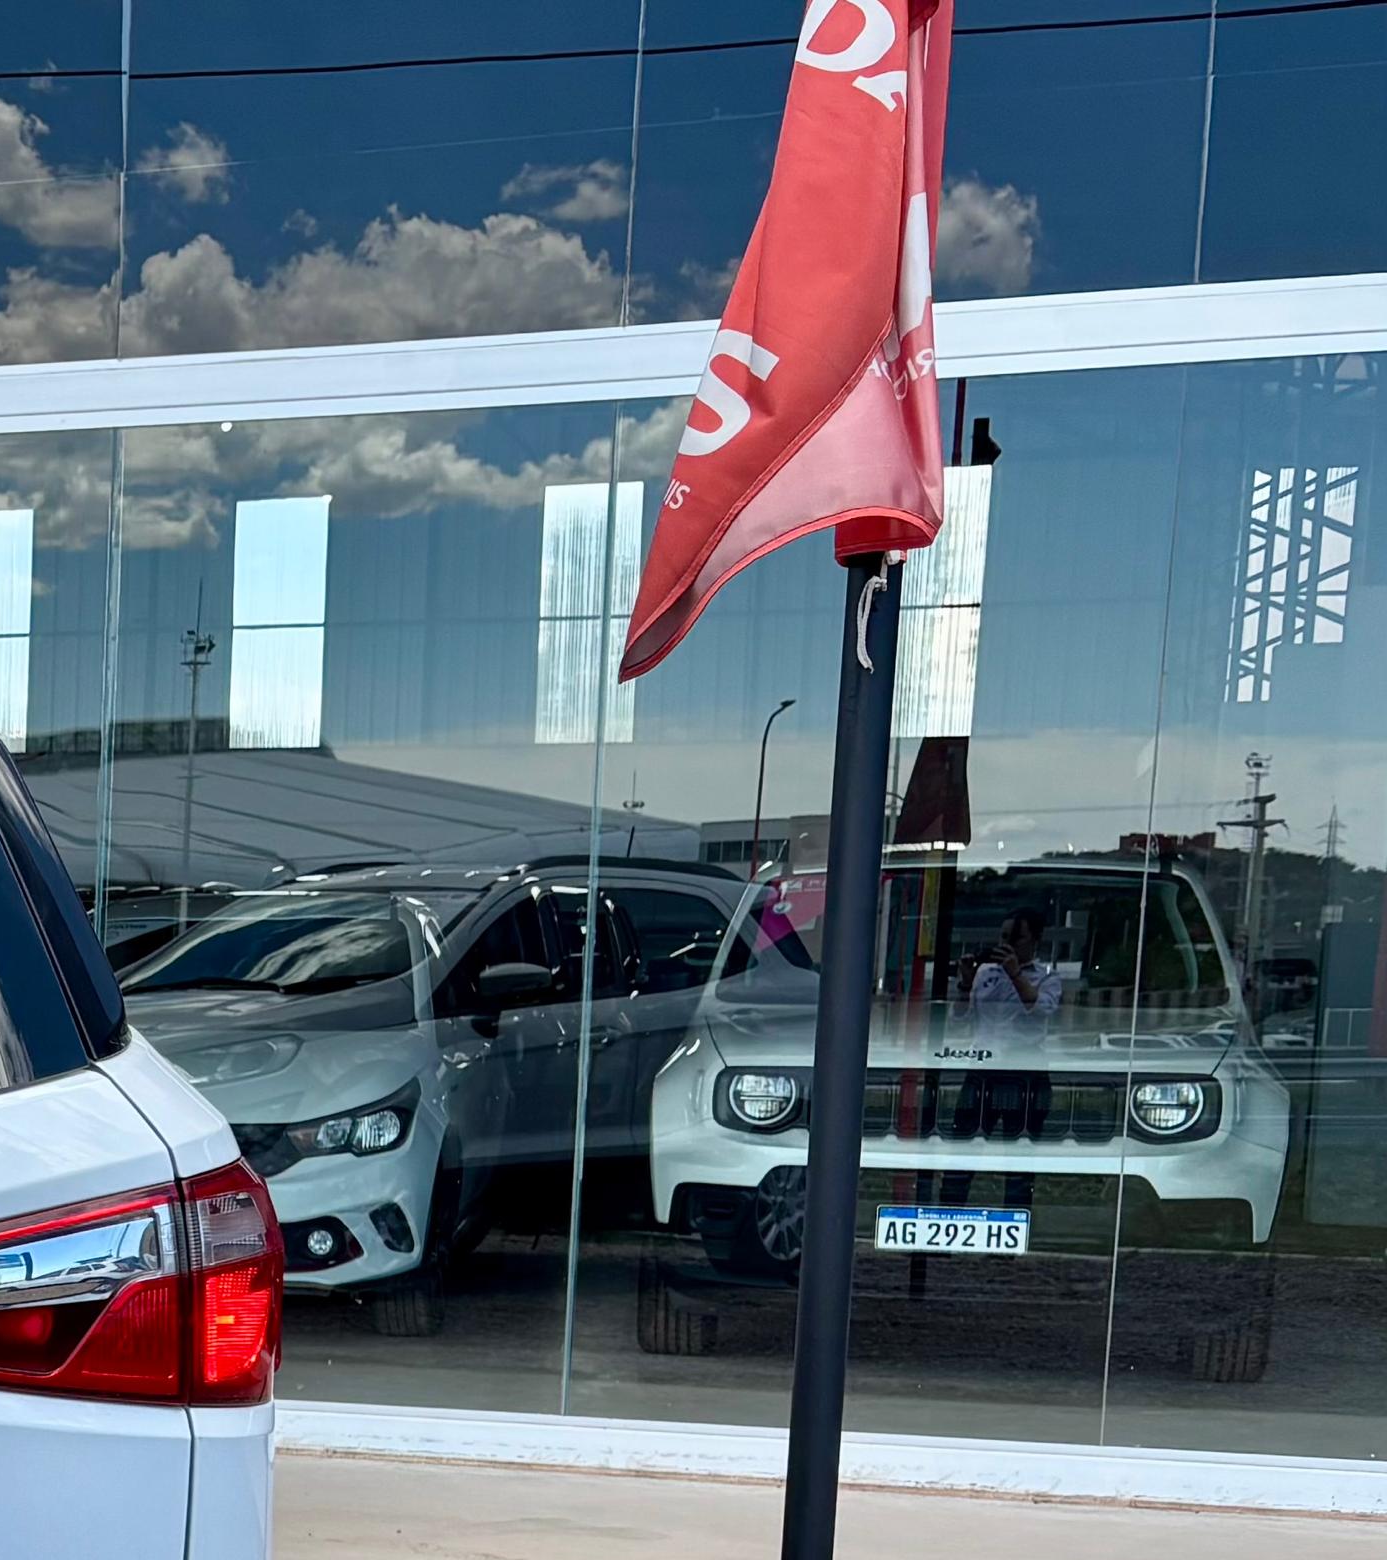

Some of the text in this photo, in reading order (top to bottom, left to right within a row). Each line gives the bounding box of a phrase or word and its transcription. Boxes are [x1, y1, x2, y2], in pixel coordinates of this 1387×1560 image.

[934, 1047, 993, 1062] Jeep
[884, 1221, 1020, 1249] AG 292 HS
